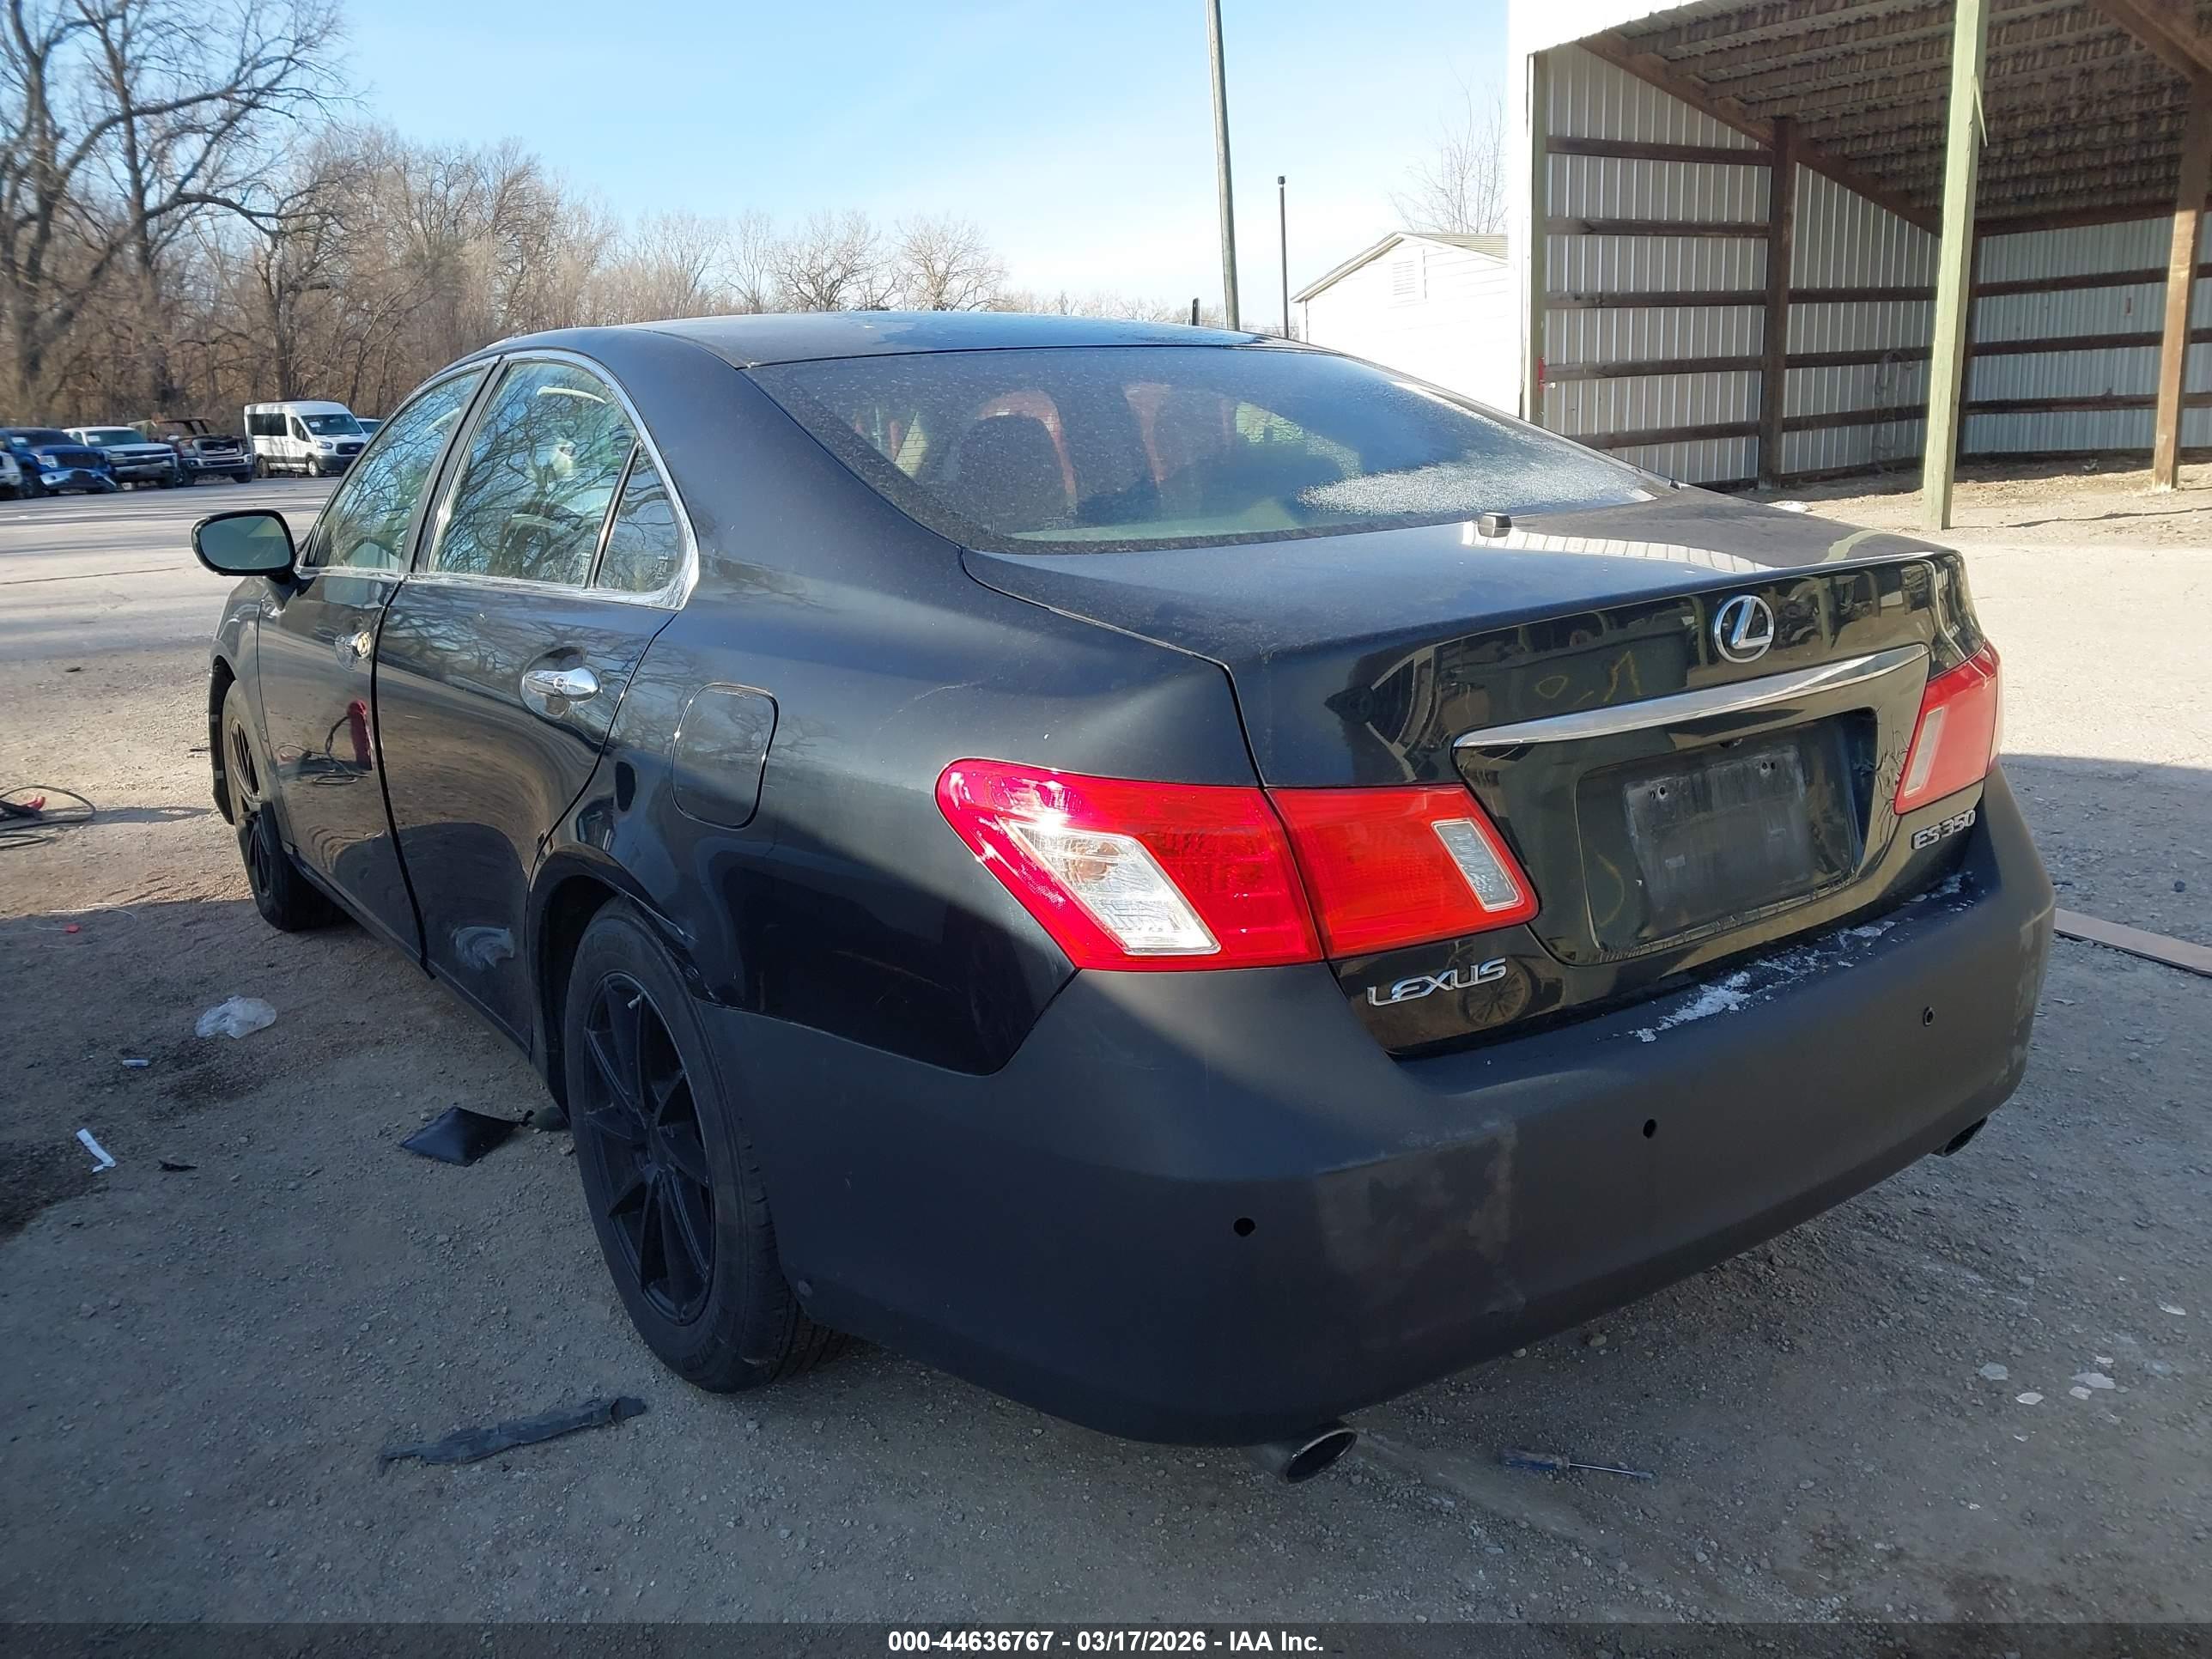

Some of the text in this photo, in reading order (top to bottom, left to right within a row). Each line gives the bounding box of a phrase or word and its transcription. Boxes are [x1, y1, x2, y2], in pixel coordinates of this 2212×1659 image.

[1912, 810, 1976, 849] ES 350
[1366, 957, 1507, 1006] LEXUS
